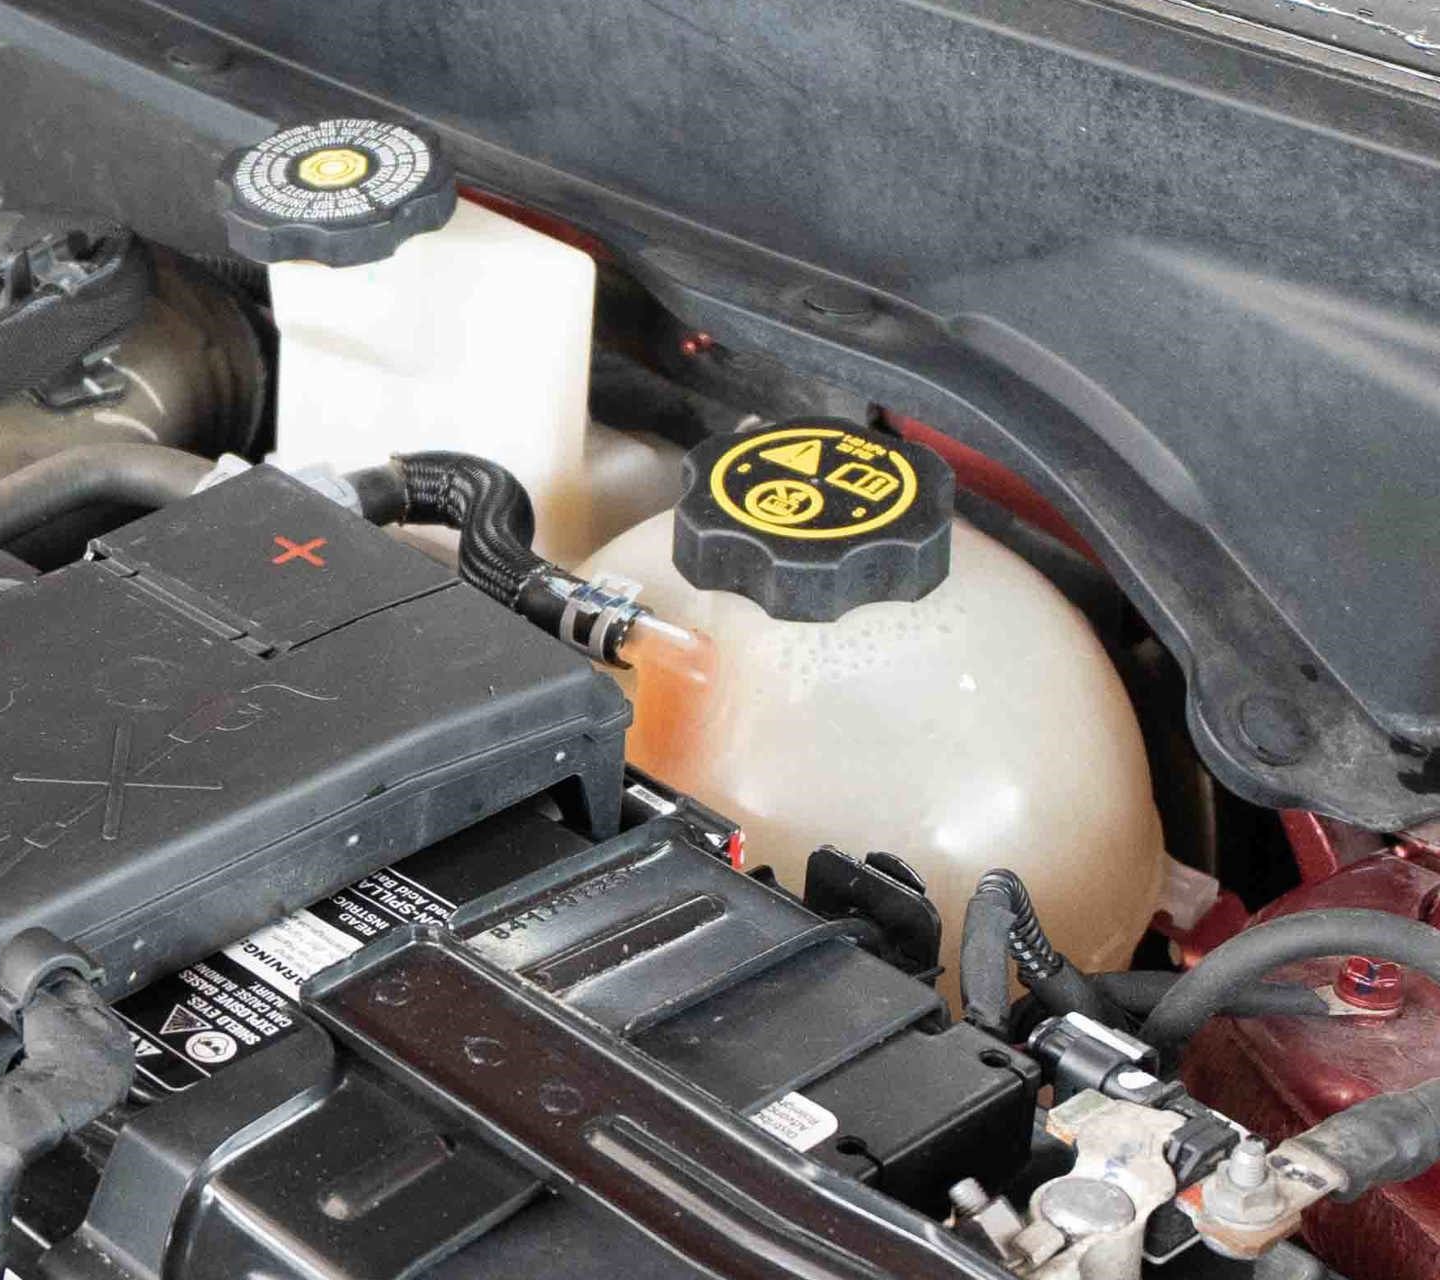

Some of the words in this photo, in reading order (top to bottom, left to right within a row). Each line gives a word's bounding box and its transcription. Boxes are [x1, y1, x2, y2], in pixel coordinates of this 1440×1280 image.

[320, 119, 377, 128] NETTOYER
[368, 871, 397, 888] Bat
[394, 885, 429, 905] Acid
[328, 892, 389, 929] INSTRUC
[337, 912, 377, 936] READ
[176, 968, 220, 996] GASES
[181, 993, 223, 1019] EYES.
[230, 987, 272, 1013] CAUSE
[211, 992, 280, 1036] EXPLOSIVE
[265, 1010, 293, 1027] CAN
[213, 1014, 262, 1045] SHIELD
